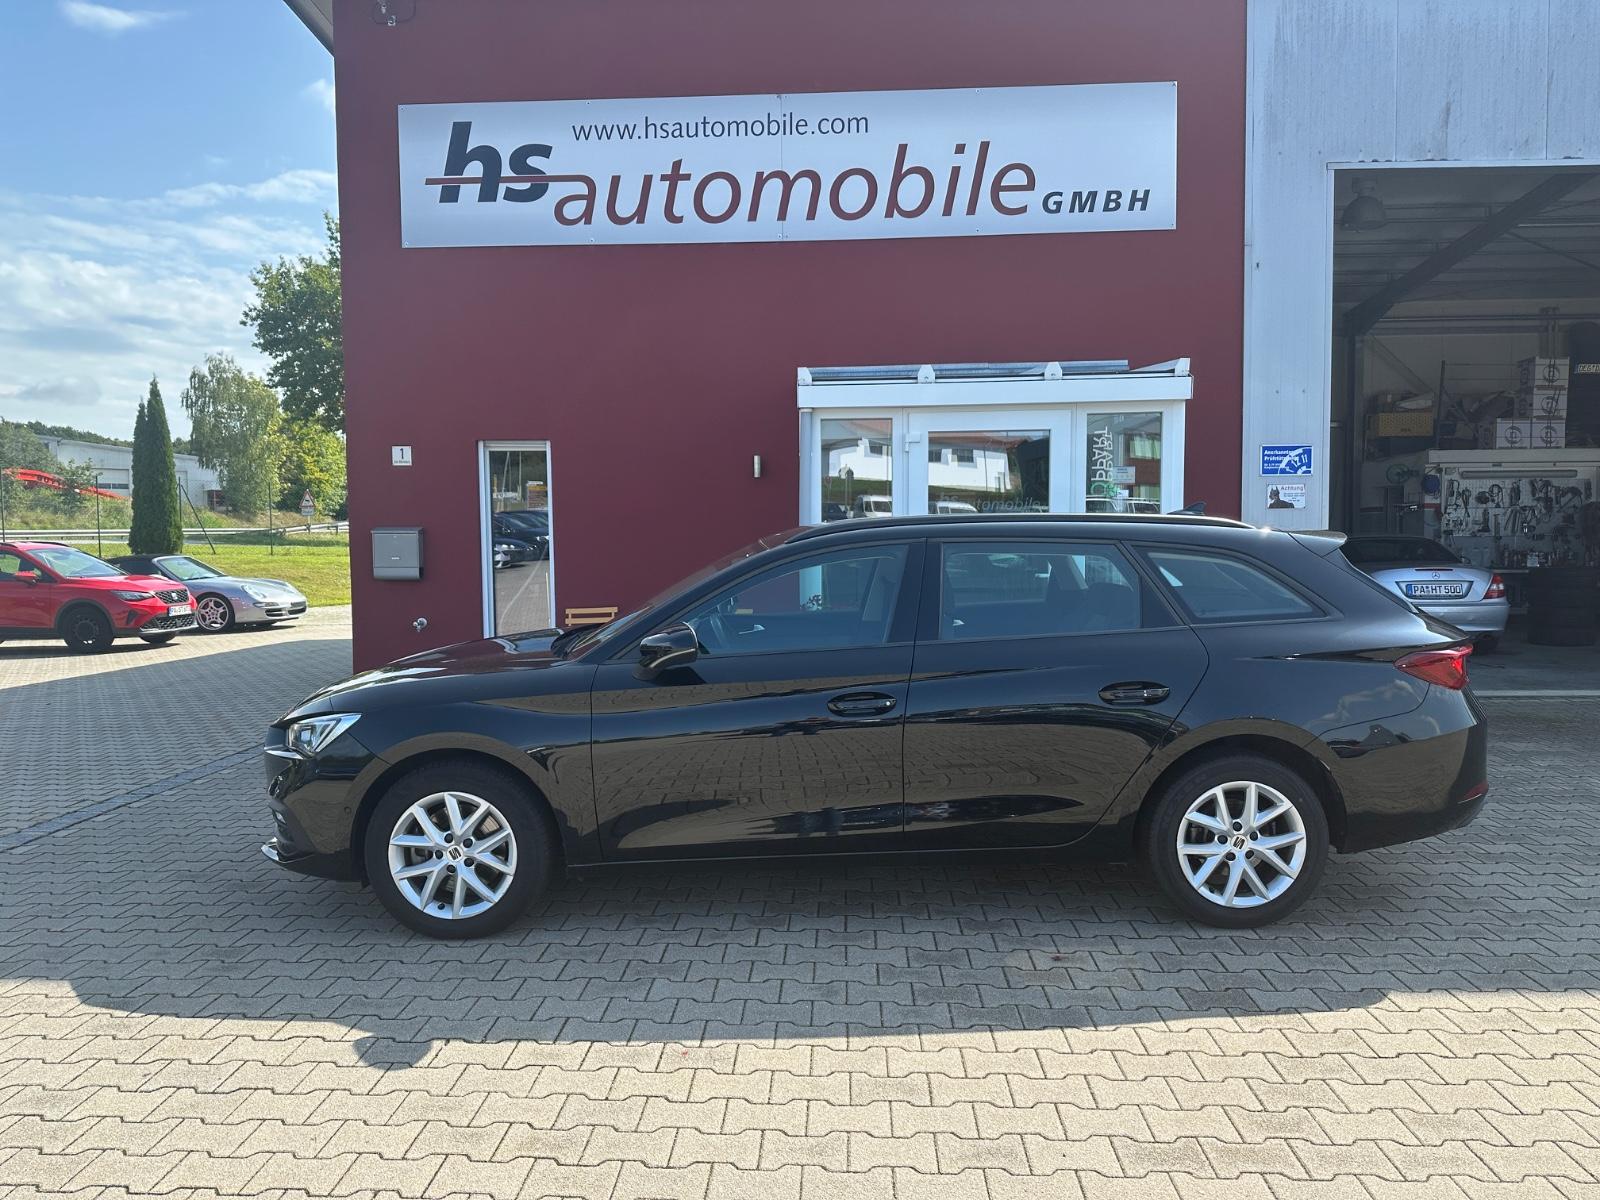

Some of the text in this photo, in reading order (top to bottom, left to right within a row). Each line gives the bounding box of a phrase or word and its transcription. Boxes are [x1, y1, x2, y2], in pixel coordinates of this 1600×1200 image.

[572, 112, 869, 140] www.hsautomobile.com
[439, 121, 1151, 225] hs automobile GMBH
[400, 448, 404, 459] 1
[1413, 585, 1461, 593] PA HT 500
